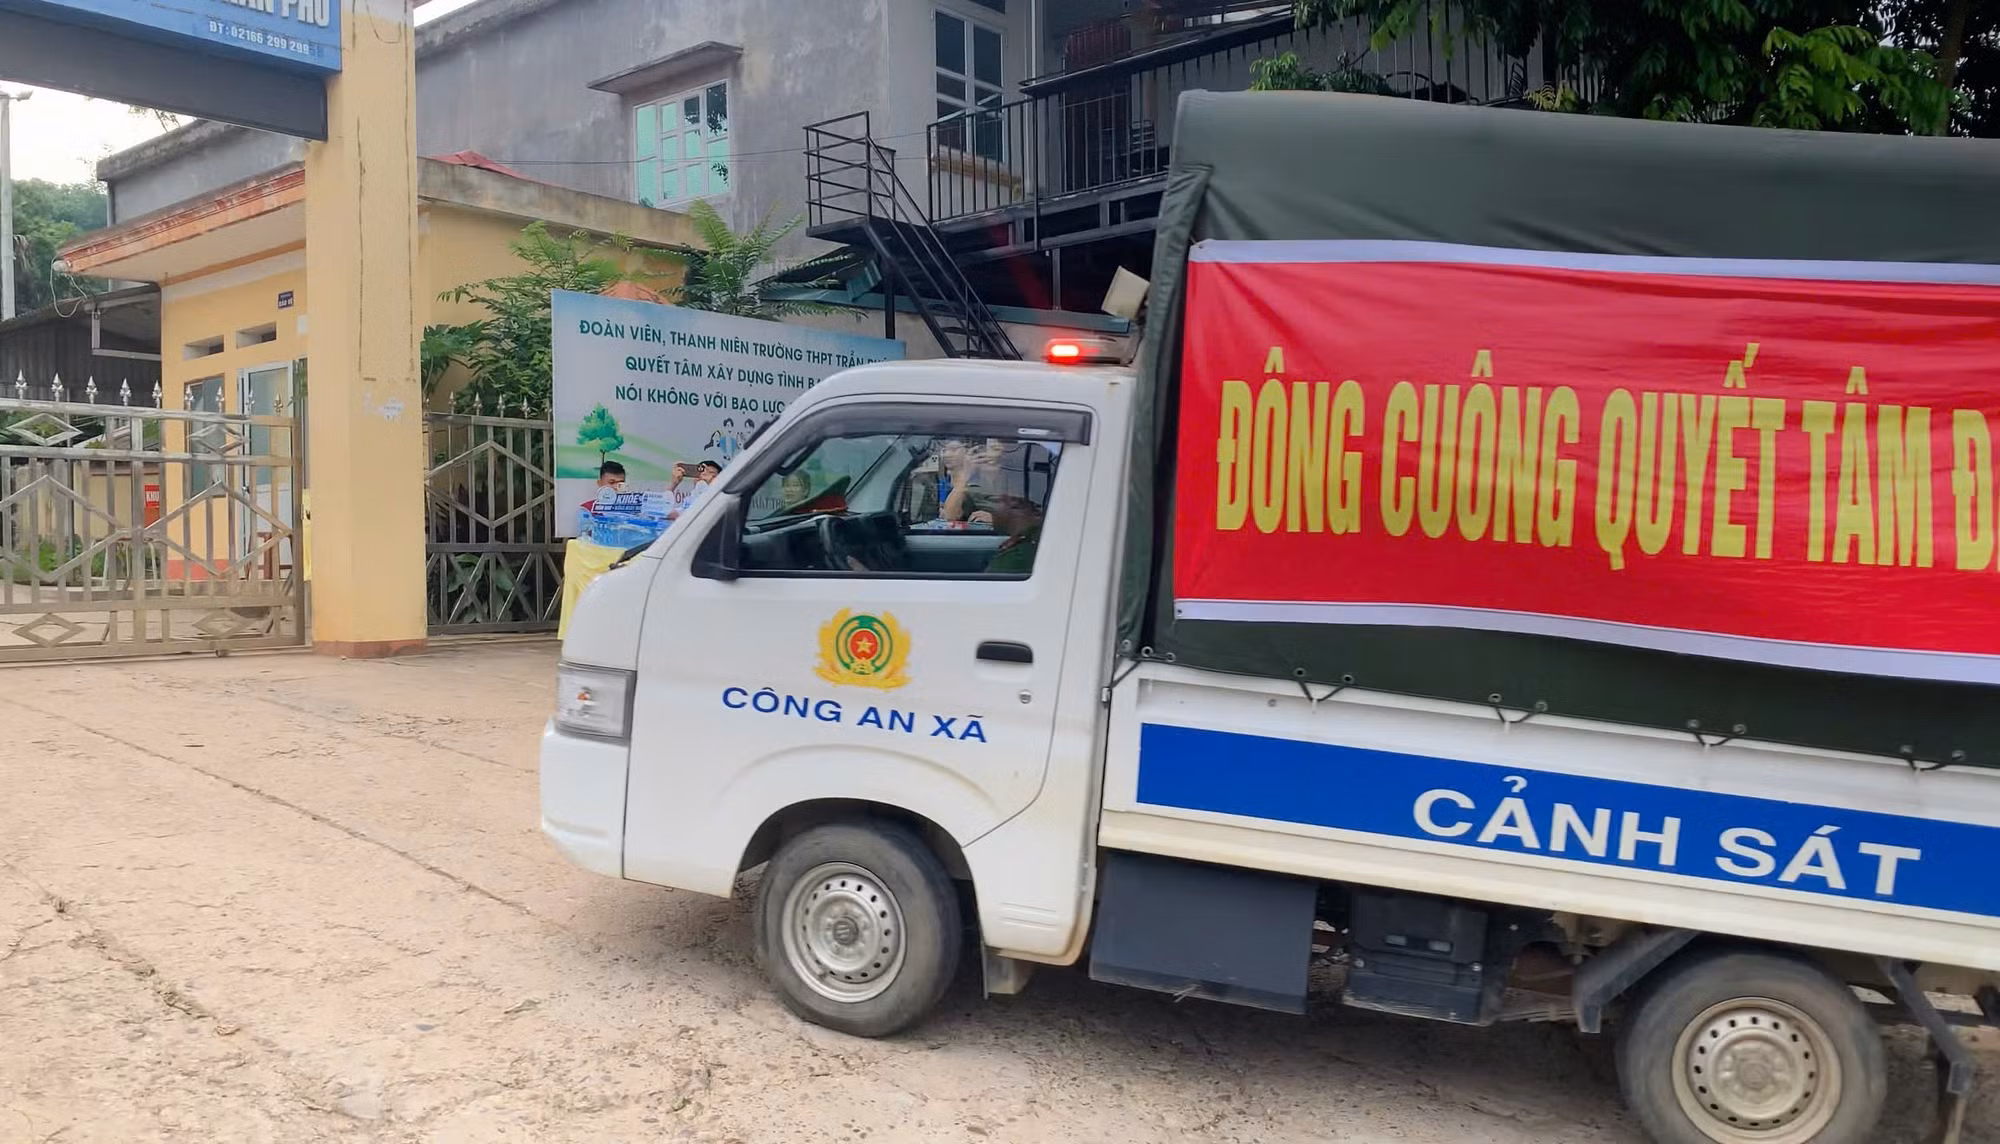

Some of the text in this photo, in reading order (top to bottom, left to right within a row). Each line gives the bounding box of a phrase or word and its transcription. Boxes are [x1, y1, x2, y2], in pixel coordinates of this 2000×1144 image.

[579, 319, 625, 339] ĐOÀN
[629, 324, 666, 346] VIÊN,
[670, 331, 716, 350] THANH
[720, 336, 749, 354] NIÊN
[753, 342, 803, 361] TRƯỜNG
[806, 350, 833, 365] THPT
[625, 354, 670, 374] QUYẾT
[674, 358, 702, 377] TÂM
[707, 363, 733, 381] XÂY
[738, 369, 774, 387] DỰNG
[778, 370, 804, 389] TÌNH
[615, 383, 785, 417] NÓI KHÔNG VỚI BẠO LỰC
[1216, 342, 2000, 571] ĐÔNG CUÔNG QUYẾT TÂM Đ
[722, 686, 987, 743] CÔNG AN XÃ
[1412, 775, 1922, 896] CẢNH SÁT
